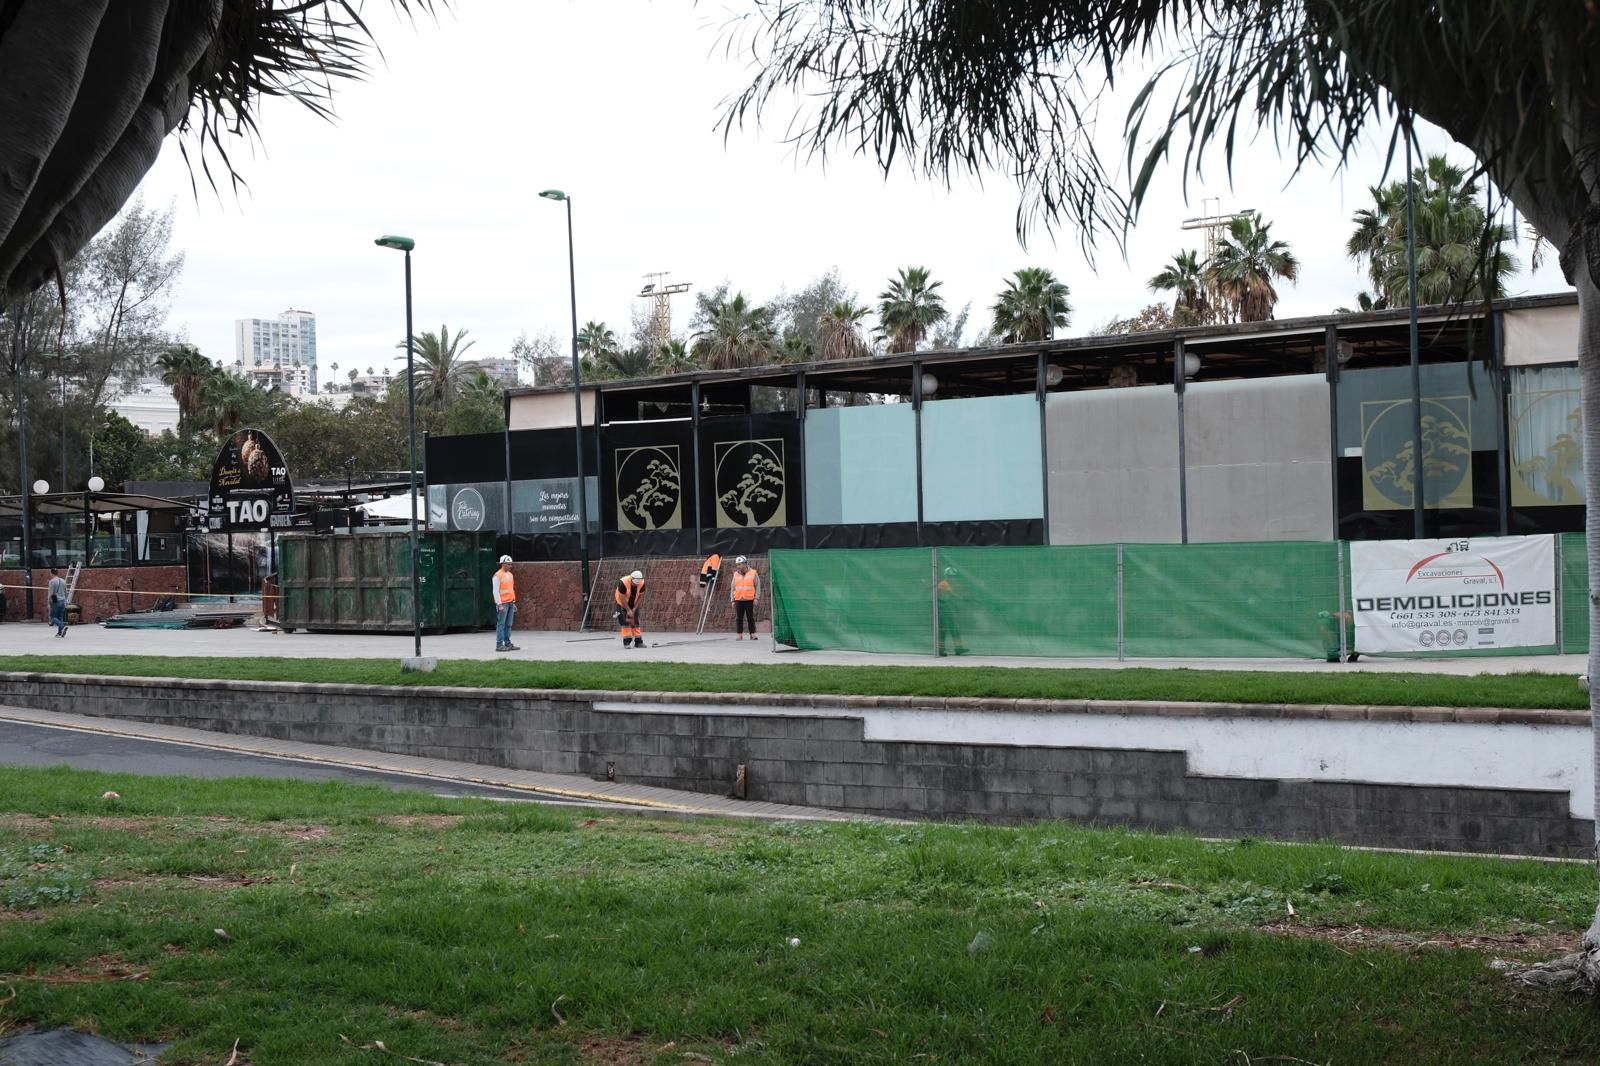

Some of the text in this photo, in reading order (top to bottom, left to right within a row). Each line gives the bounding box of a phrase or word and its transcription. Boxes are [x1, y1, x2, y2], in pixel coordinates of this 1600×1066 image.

[271, 467, 286, 476] TAO
[226, 499, 268, 523] TAO
[458, 507, 480, 521] Catering
[1417, 569, 1463, 578] Excavaciones
[1357, 590, 1551, 612] DEMOLICIONES
[1396, 612, 1413, 620] 661
[1416, 611, 1434, 619] 535
[1439, 610, 1457, 618] 308
[1463, 609, 1480, 617] 673
[1483, 608, 1500, 616] 841
[1391, 619, 1453, 629] info@graval.es
